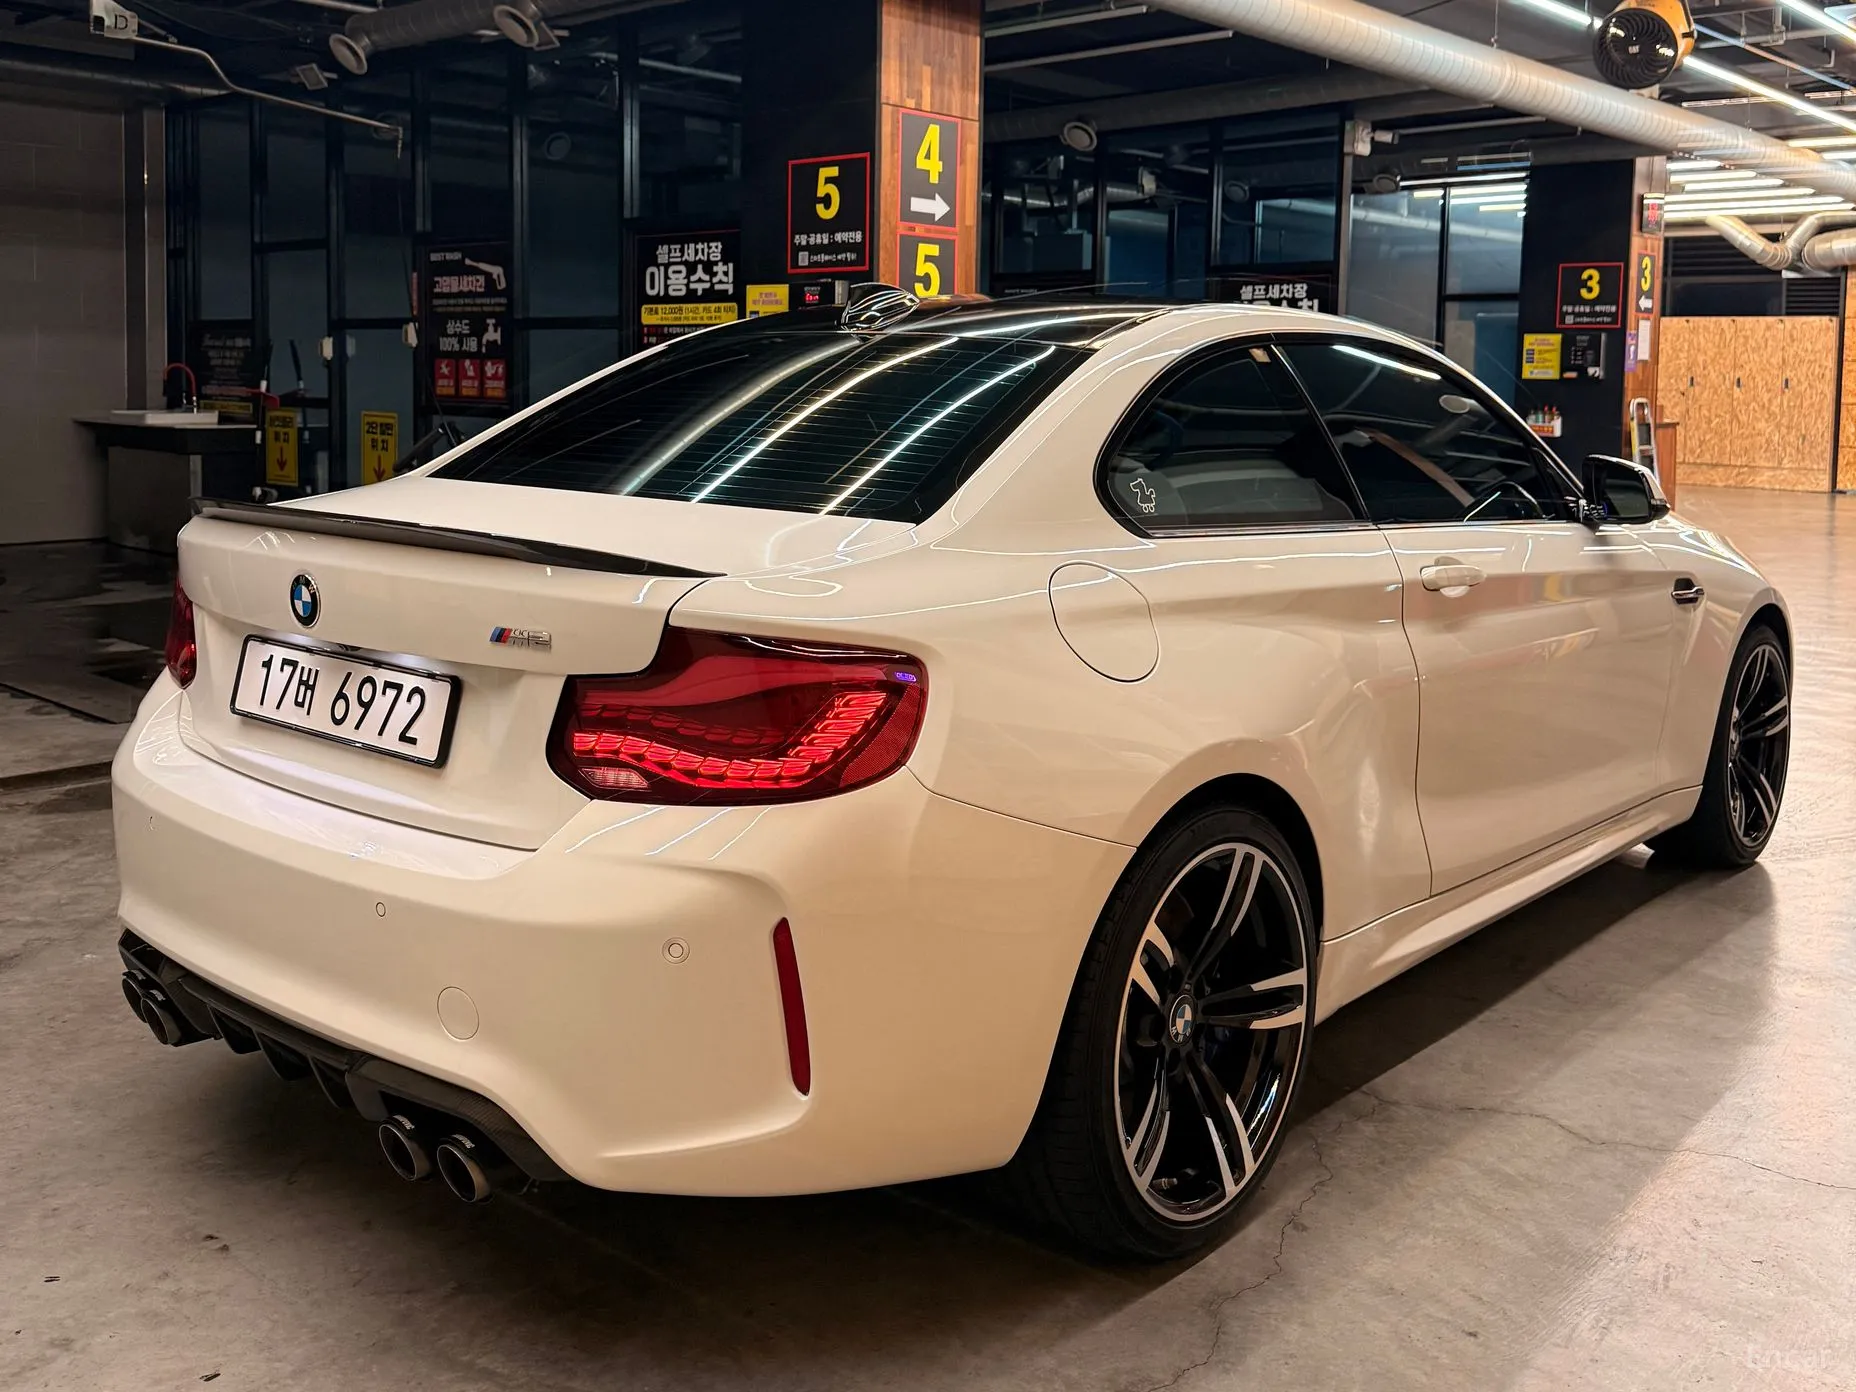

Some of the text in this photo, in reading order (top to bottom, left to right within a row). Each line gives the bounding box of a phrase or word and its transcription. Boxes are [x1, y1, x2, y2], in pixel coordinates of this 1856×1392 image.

[916, 124, 943, 183] 4
[815, 166, 841, 220] 5
[656, 242, 722, 263] 셀프세차장
[645, 262, 734, 297] 이용수칙
[914, 243, 941, 298] 5
[1580, 268, 1600, 300] 3
[1641, 256, 1652, 291] 3
[1240, 283, 1308, 300] 셀프세차장
[260, 653, 426, 746] 17버 6972
